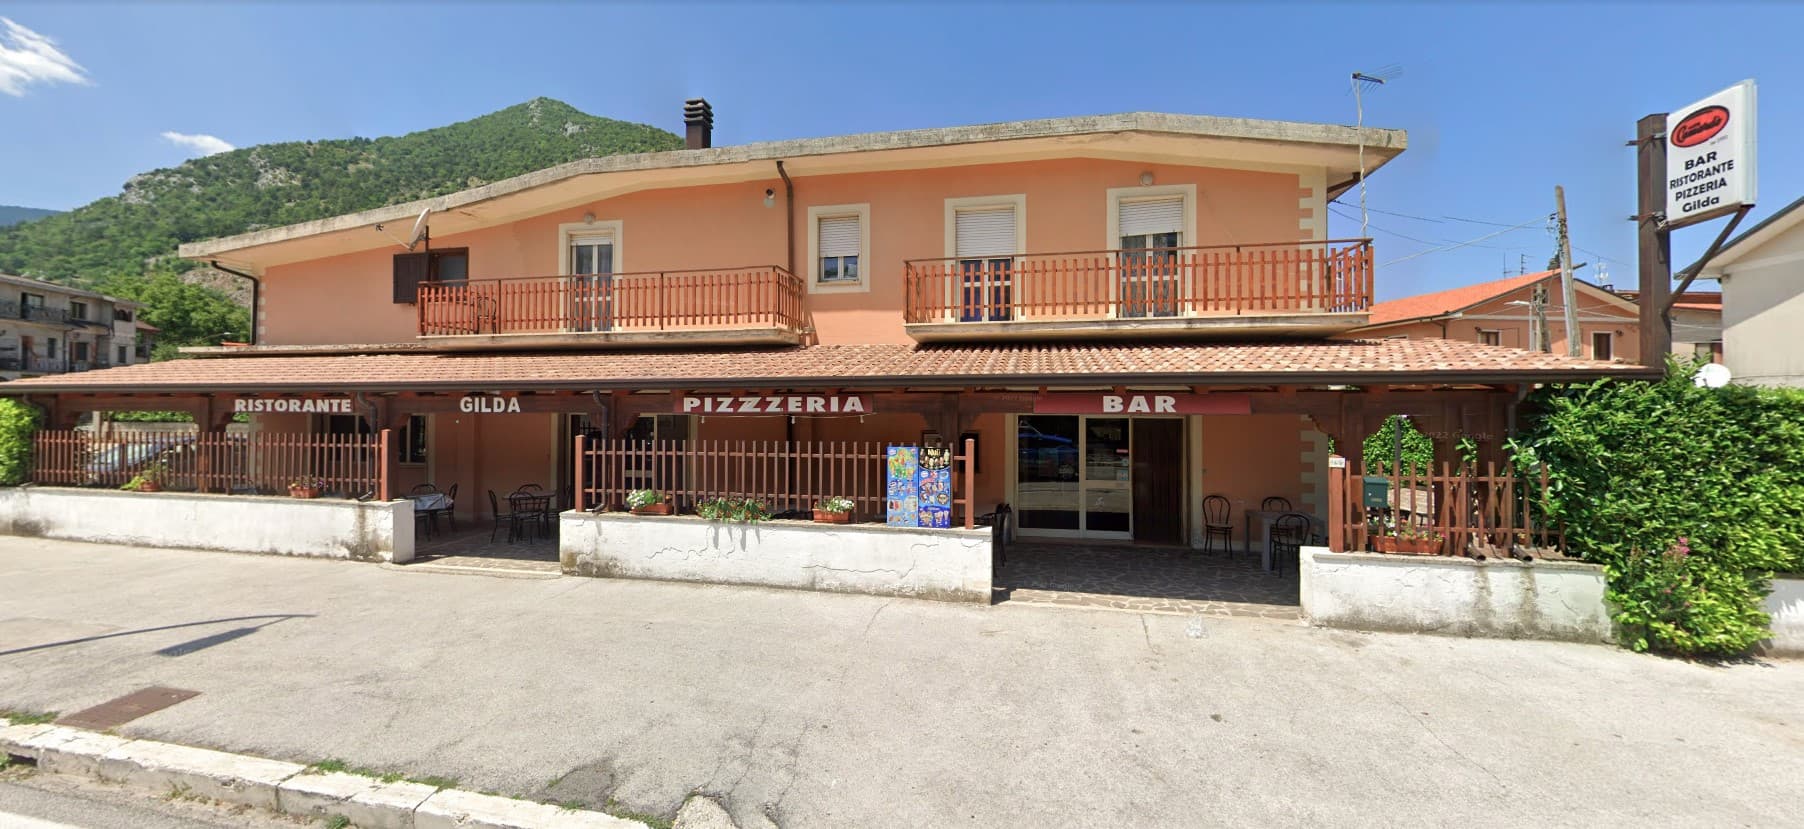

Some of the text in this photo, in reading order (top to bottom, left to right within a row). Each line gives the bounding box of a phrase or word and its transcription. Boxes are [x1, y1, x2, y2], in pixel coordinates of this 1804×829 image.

[1685, 151, 1717, 170] BAR
[1670, 160, 1734, 190] RISTORANTE
[1675, 177, 1727, 201] PIZZERIA
[1682, 197, 1720, 212] Gilda
[235, 399, 352, 412] RISTORANTE
[460, 397, 521, 413] GILDA
[1103, 395, 1177, 413] BAR
